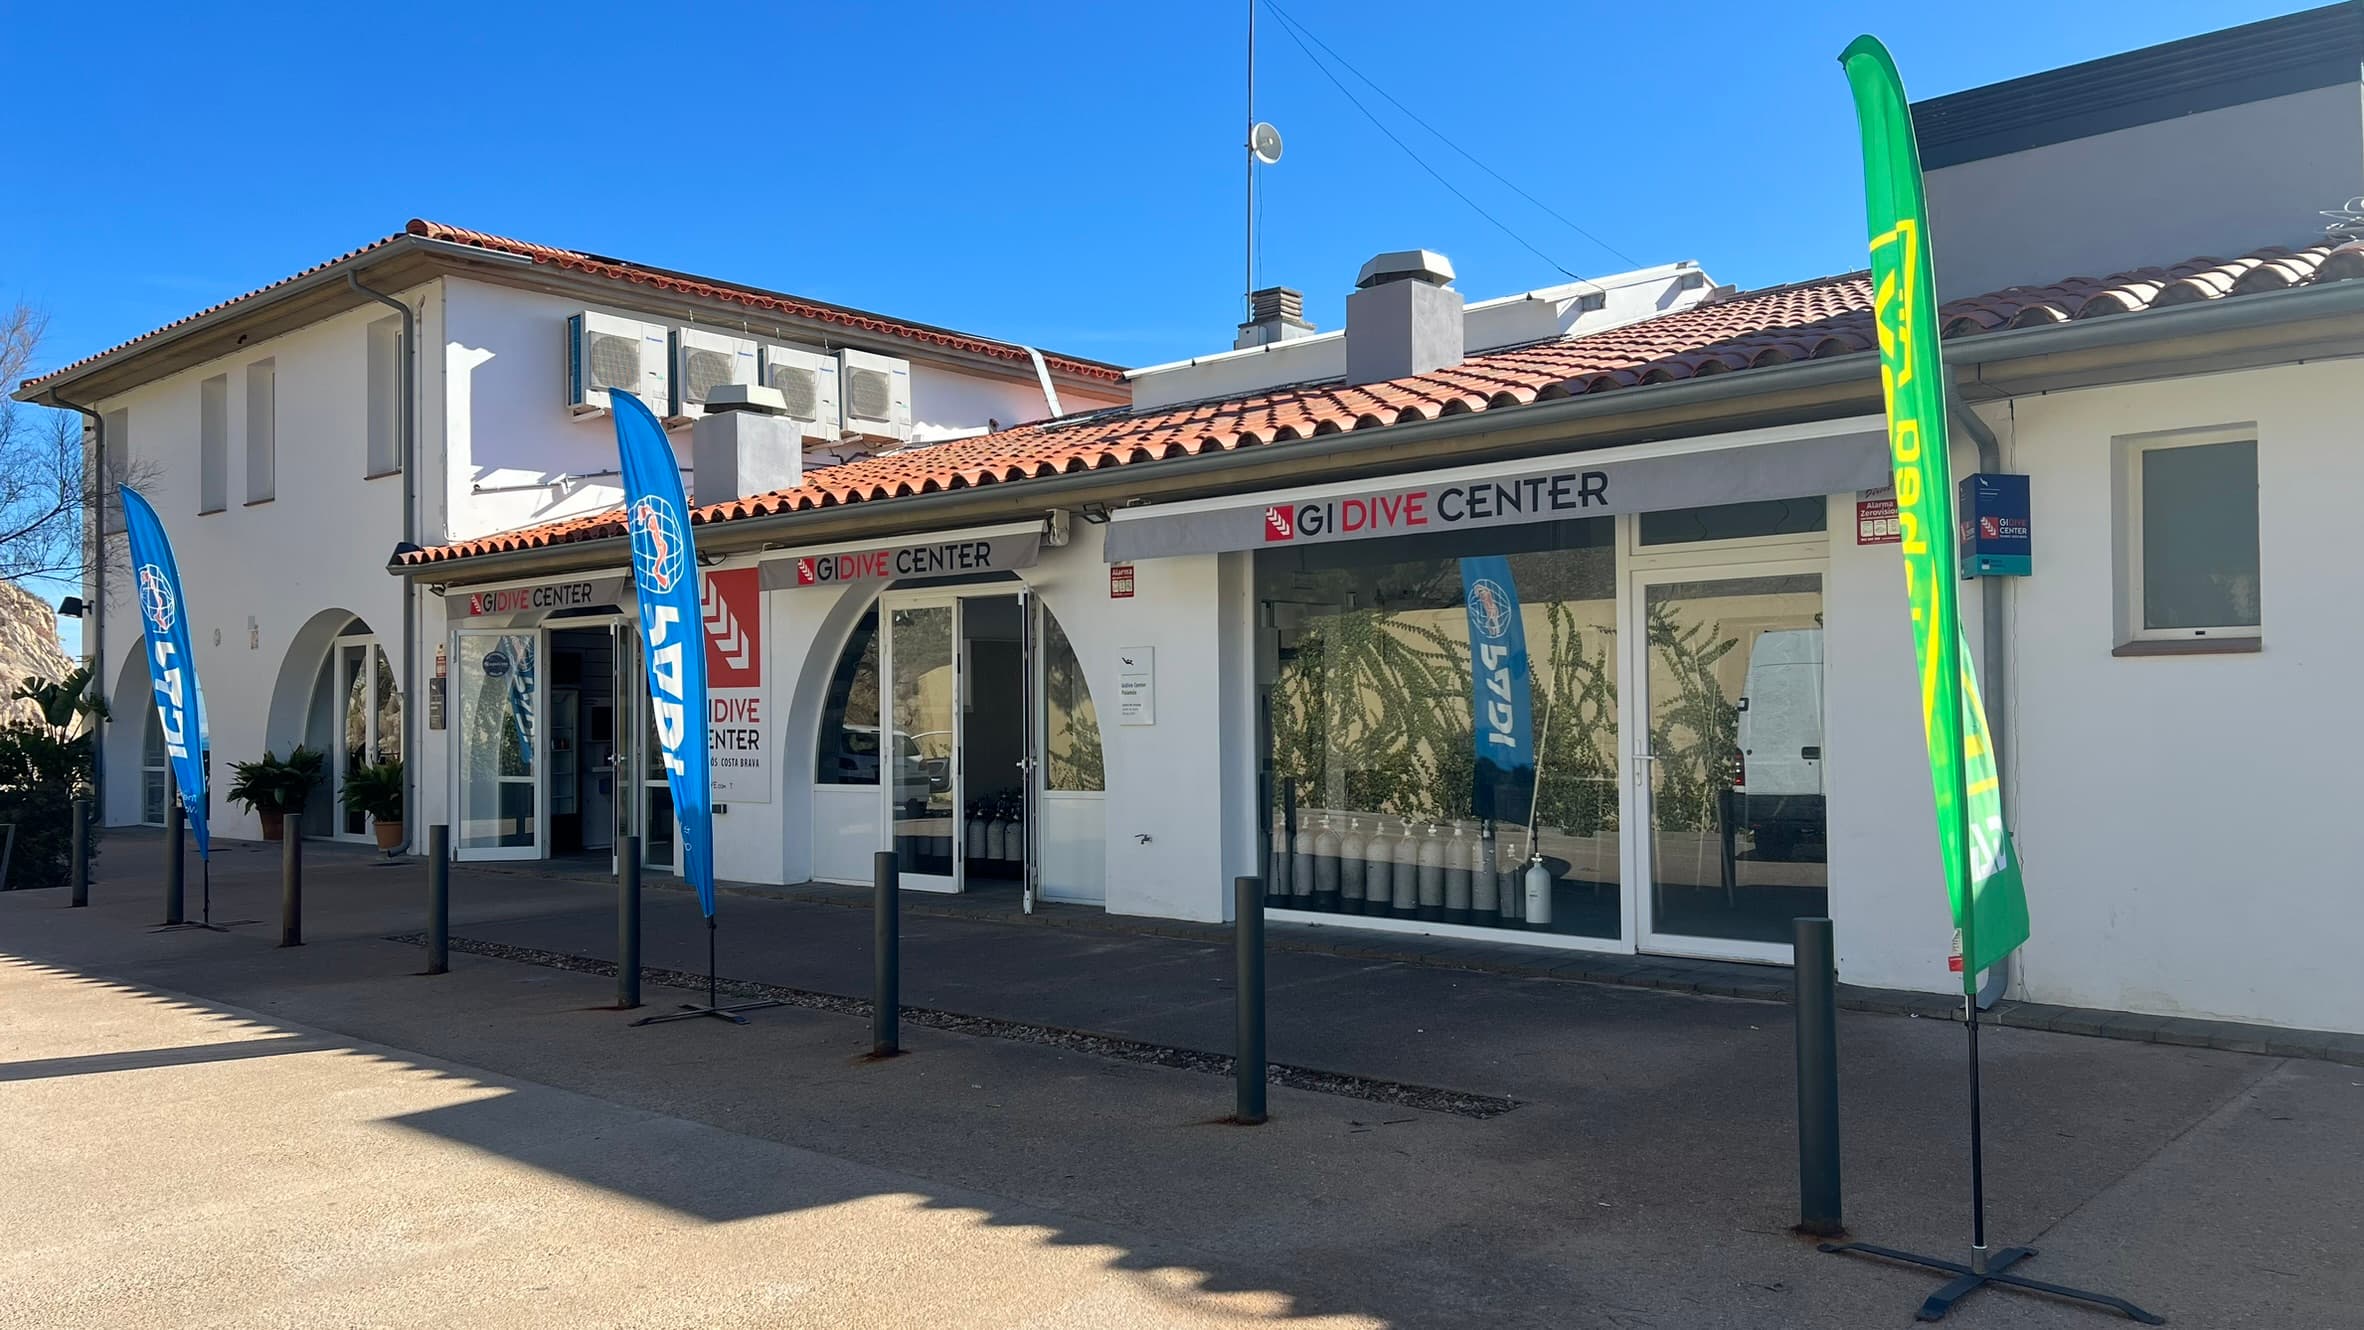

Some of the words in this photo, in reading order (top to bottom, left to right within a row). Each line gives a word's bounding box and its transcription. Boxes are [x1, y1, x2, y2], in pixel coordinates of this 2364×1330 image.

[1436, 470, 1609, 523] CENTER
[1866, 501, 1894, 510] Alarma
[1999, 527, 2028, 535] CENTER
[896, 541, 991, 574] CENTER
[532, 582, 593, 608] CENTER
[708, 698, 760, 723] IDIVE
[709, 729, 760, 750] ENTER
[721, 758, 738, 768] COSTA
[740, 758, 760, 768] BRAVA
